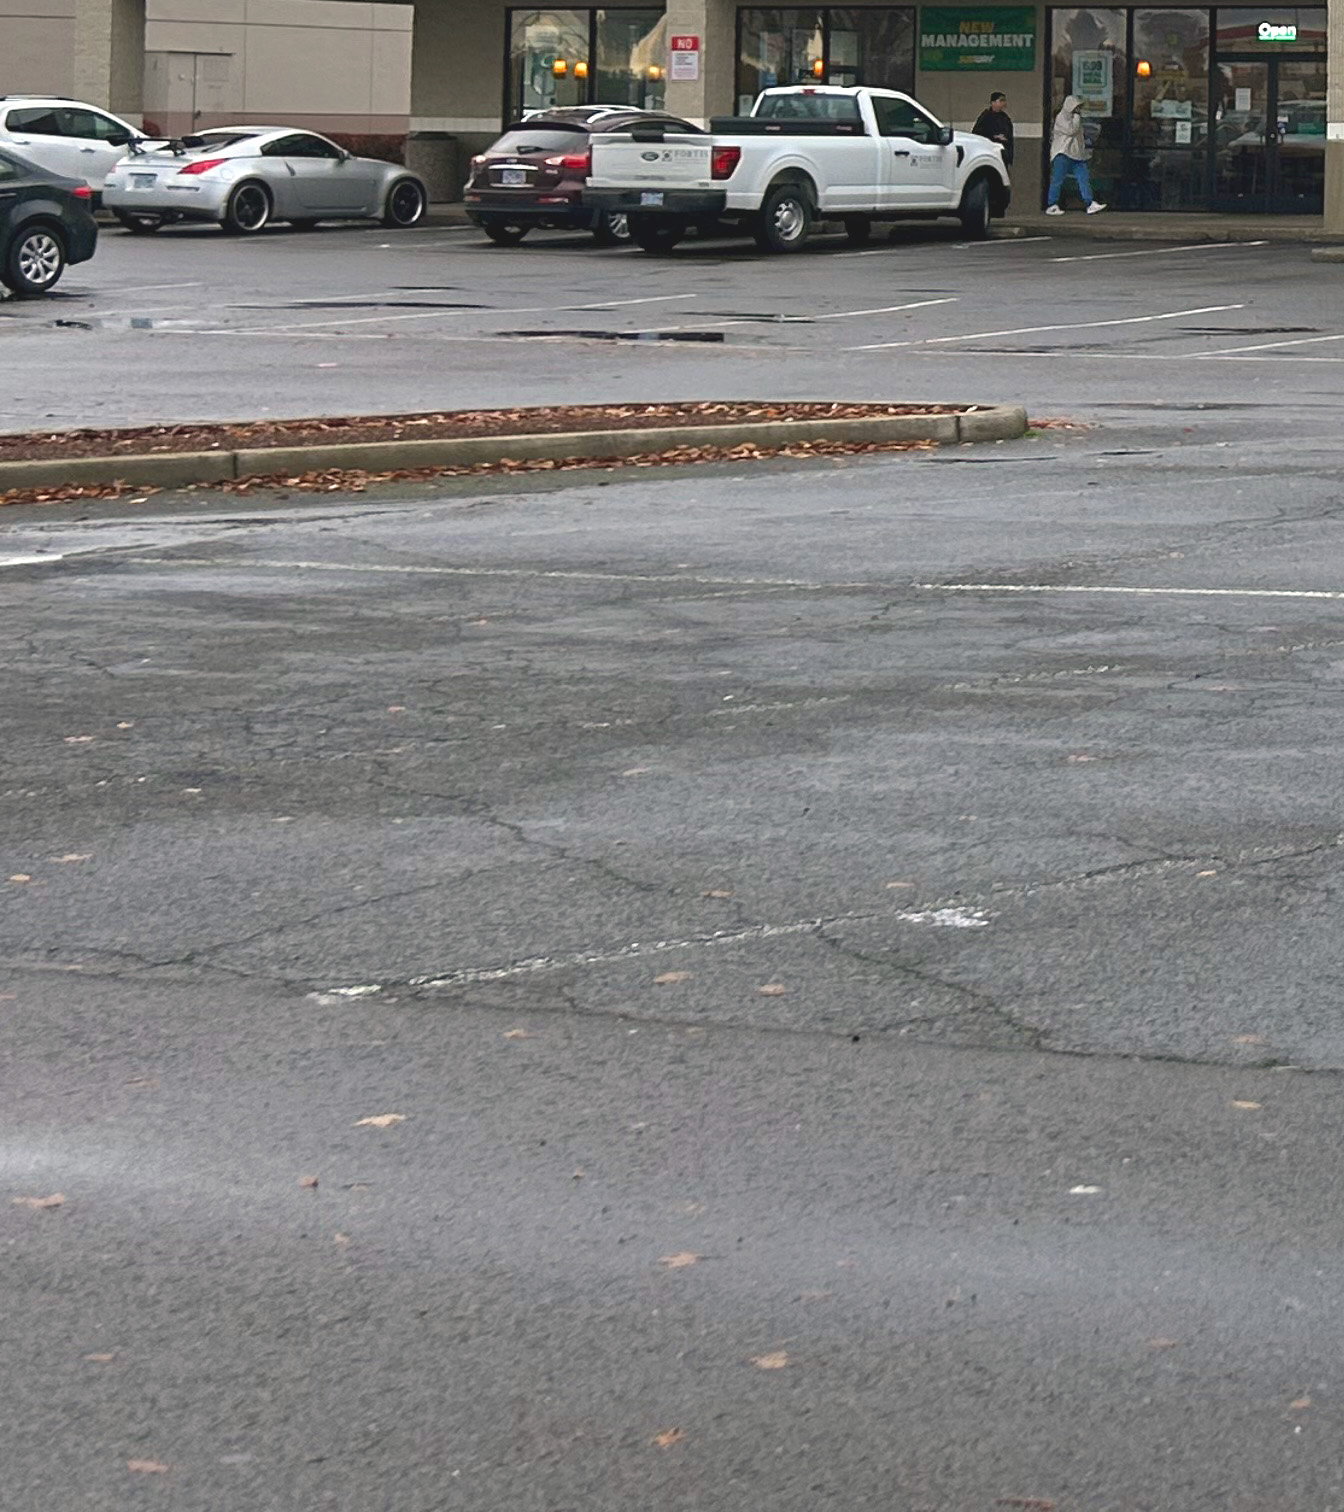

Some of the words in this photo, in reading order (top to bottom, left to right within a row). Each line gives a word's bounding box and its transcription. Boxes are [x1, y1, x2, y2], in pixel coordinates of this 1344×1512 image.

[959, 21, 994, 34] NEW
[1258, 22, 1297, 40] Open
[677, 38, 693, 50] NO
[921, 34, 1034, 48] MANAGEMENT
